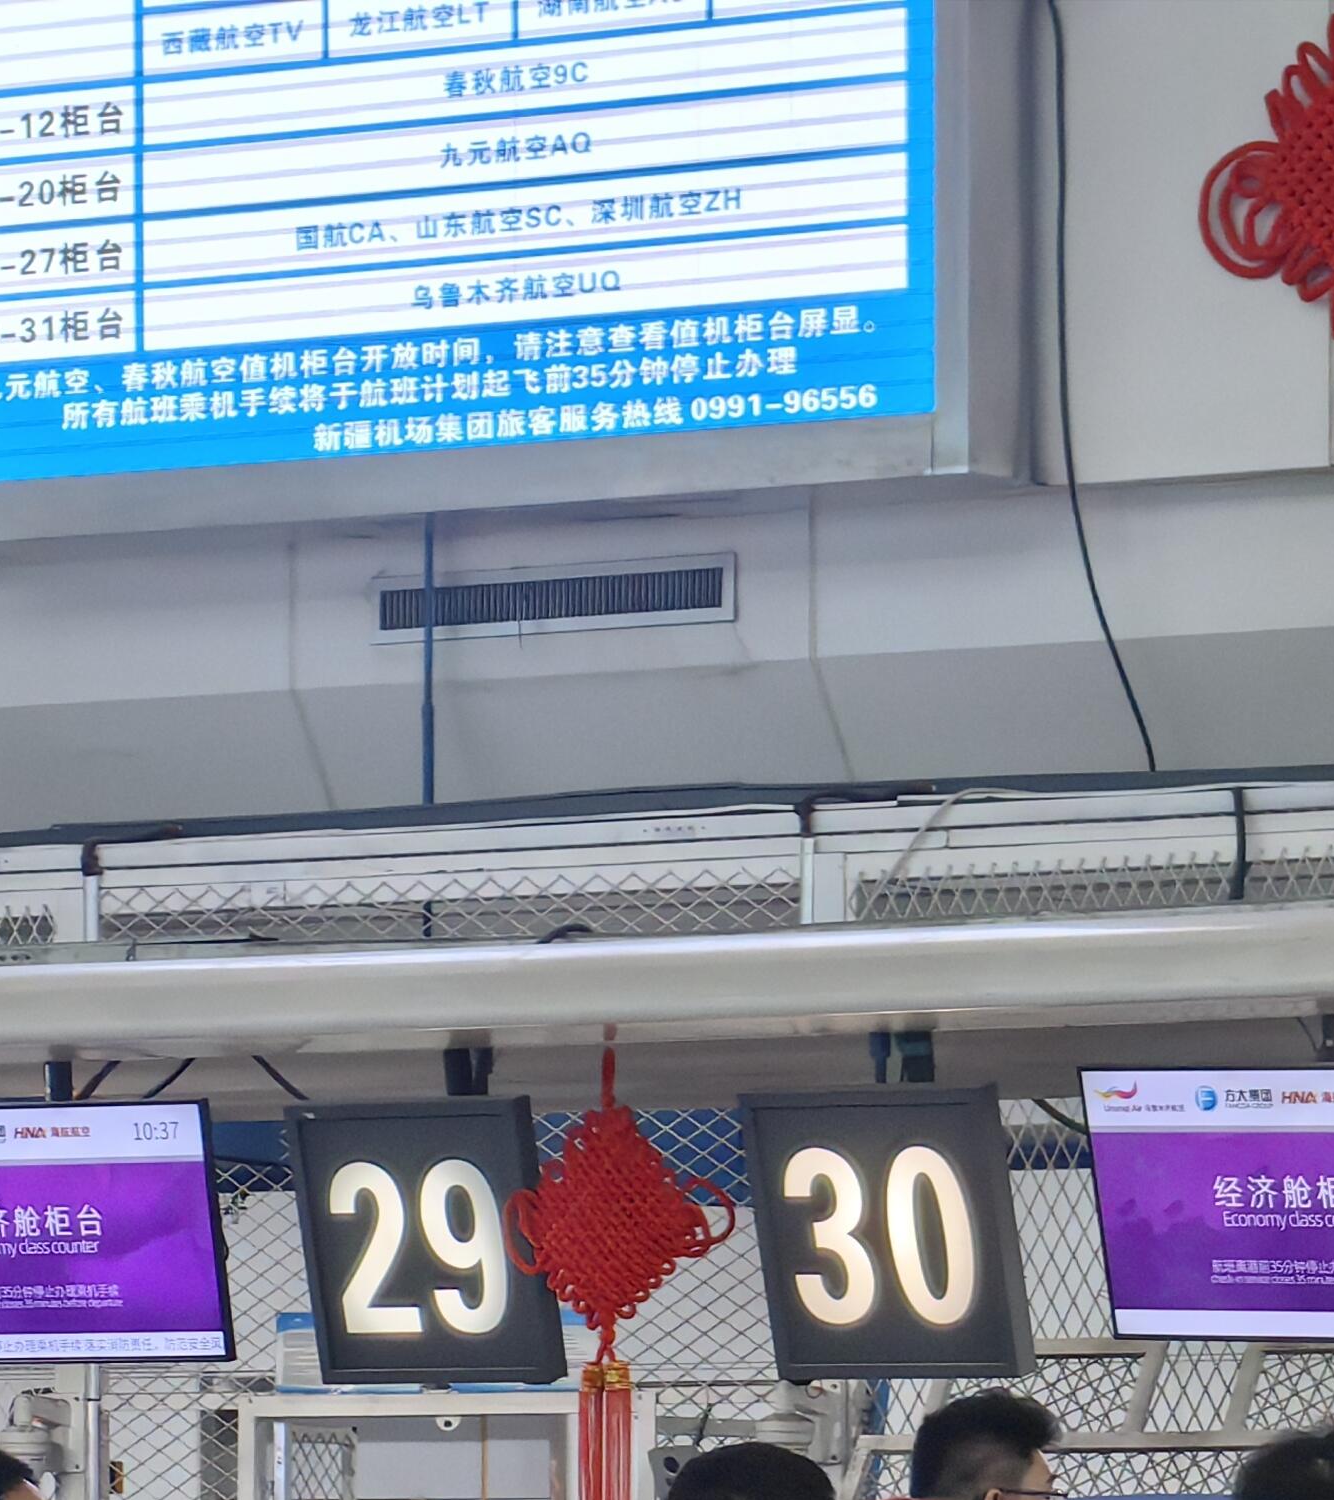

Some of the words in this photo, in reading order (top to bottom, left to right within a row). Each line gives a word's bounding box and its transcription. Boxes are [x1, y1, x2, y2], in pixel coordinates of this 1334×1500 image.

[161, 20, 304, 56] 西藏航空TV
[443, 61, 589, 99] 春秋航空9C
[440, 132, 593, 169] 九元航空AQ
[295, 188, 742, 252] 国航CA、山东航空SC、深圳航空ZH
[411, 270, 621, 310] 乌鲁木齐航空UQ
[61, 346, 798, 431] 所有航班乘机手续将于航班计划起飞前35分钟停止办理
[313, 402, 685, 453] 新疆机场集团旅客服务热线
[690, 383, 878, 422] 0991-96556
[133, 1121, 180, 1141] 10:37
[784, 1145, 975, 1326] 30
[1223, 1211, 1287, 1231] Economy
[1289, 1210, 1323, 1227] class
[18, 1238, 51, 1255] class
[51, 1239, 100, 1254] counter
[329, 1158, 509, 1335] 29
